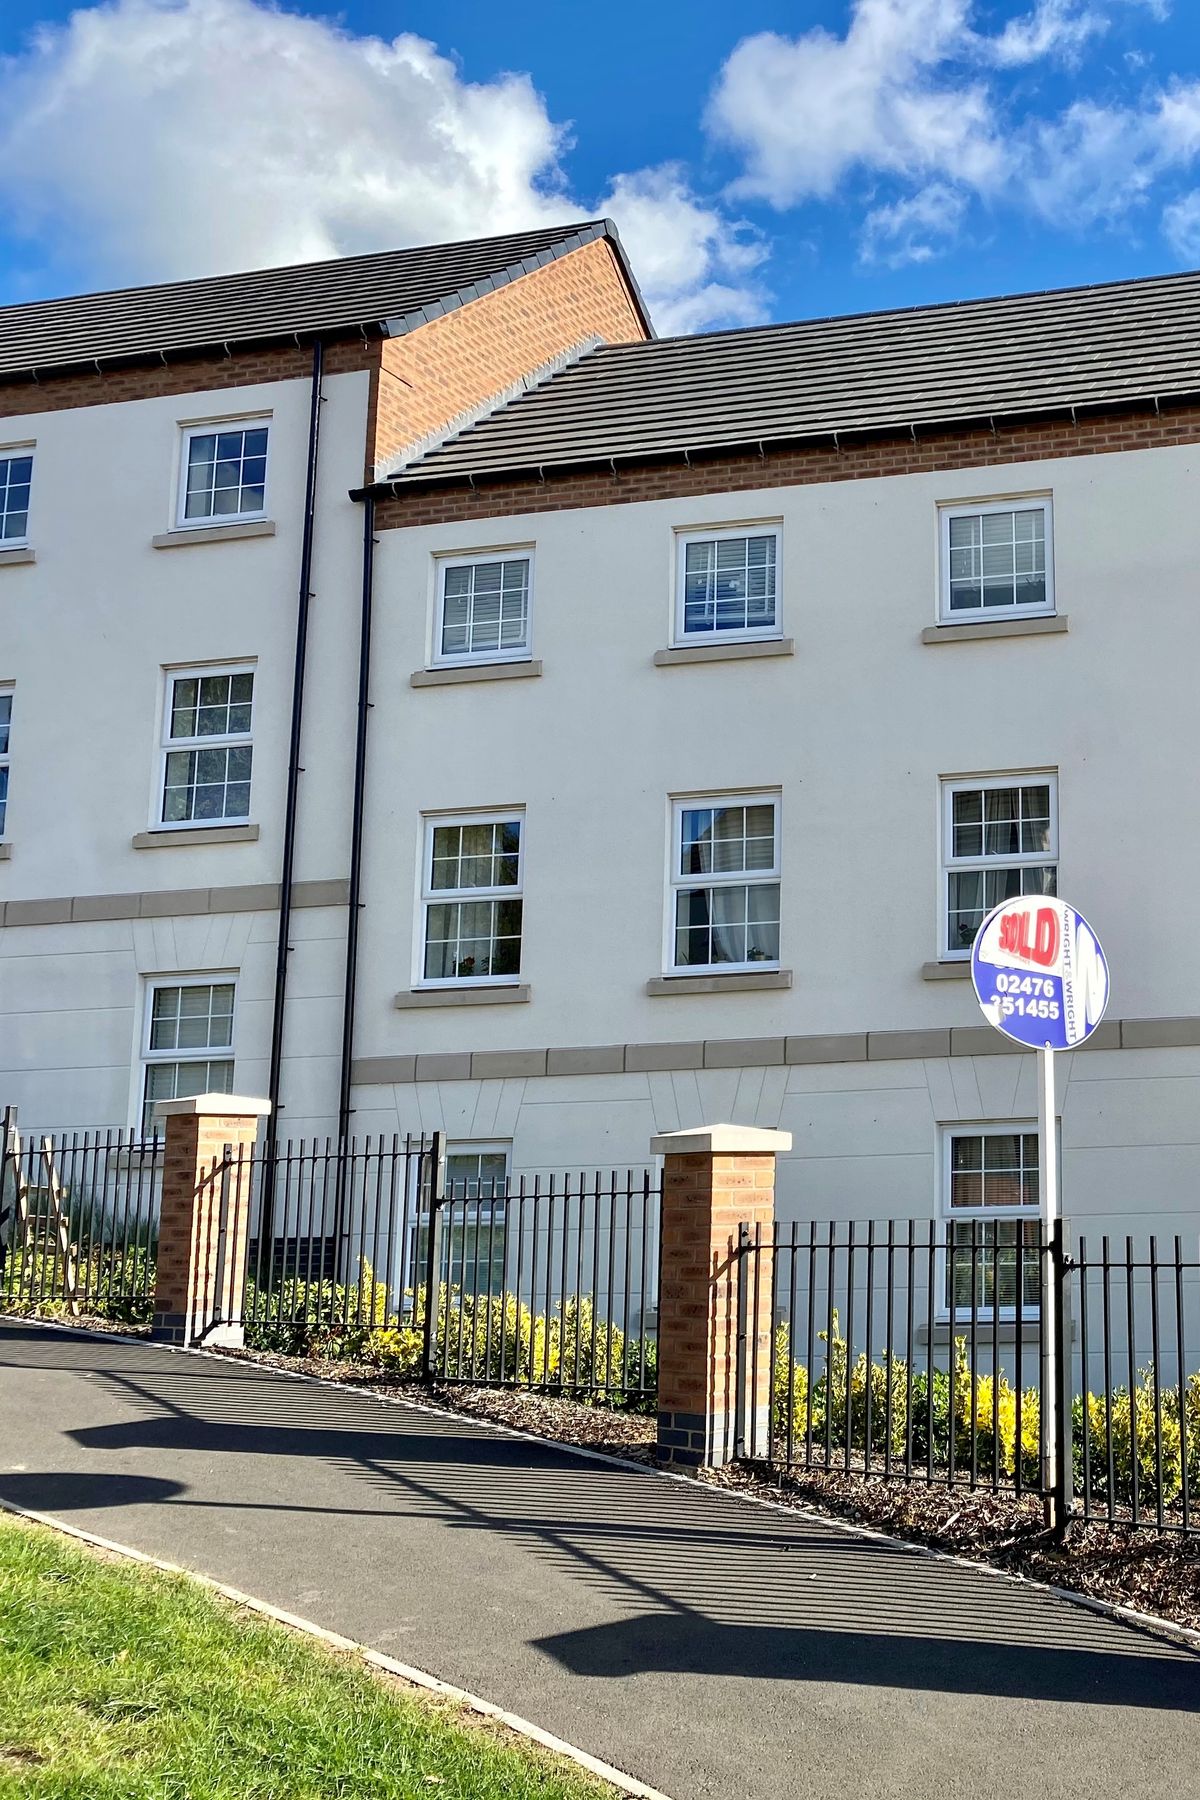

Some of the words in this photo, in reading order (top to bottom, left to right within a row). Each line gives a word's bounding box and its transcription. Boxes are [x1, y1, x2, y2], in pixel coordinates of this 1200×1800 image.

[999, 907, 1060, 968] SOLD
[1064, 907, 1072, 968] WRIGHT
[996, 974, 1054, 998] 02476
[1066, 981, 1077, 1039] WRIGHT
